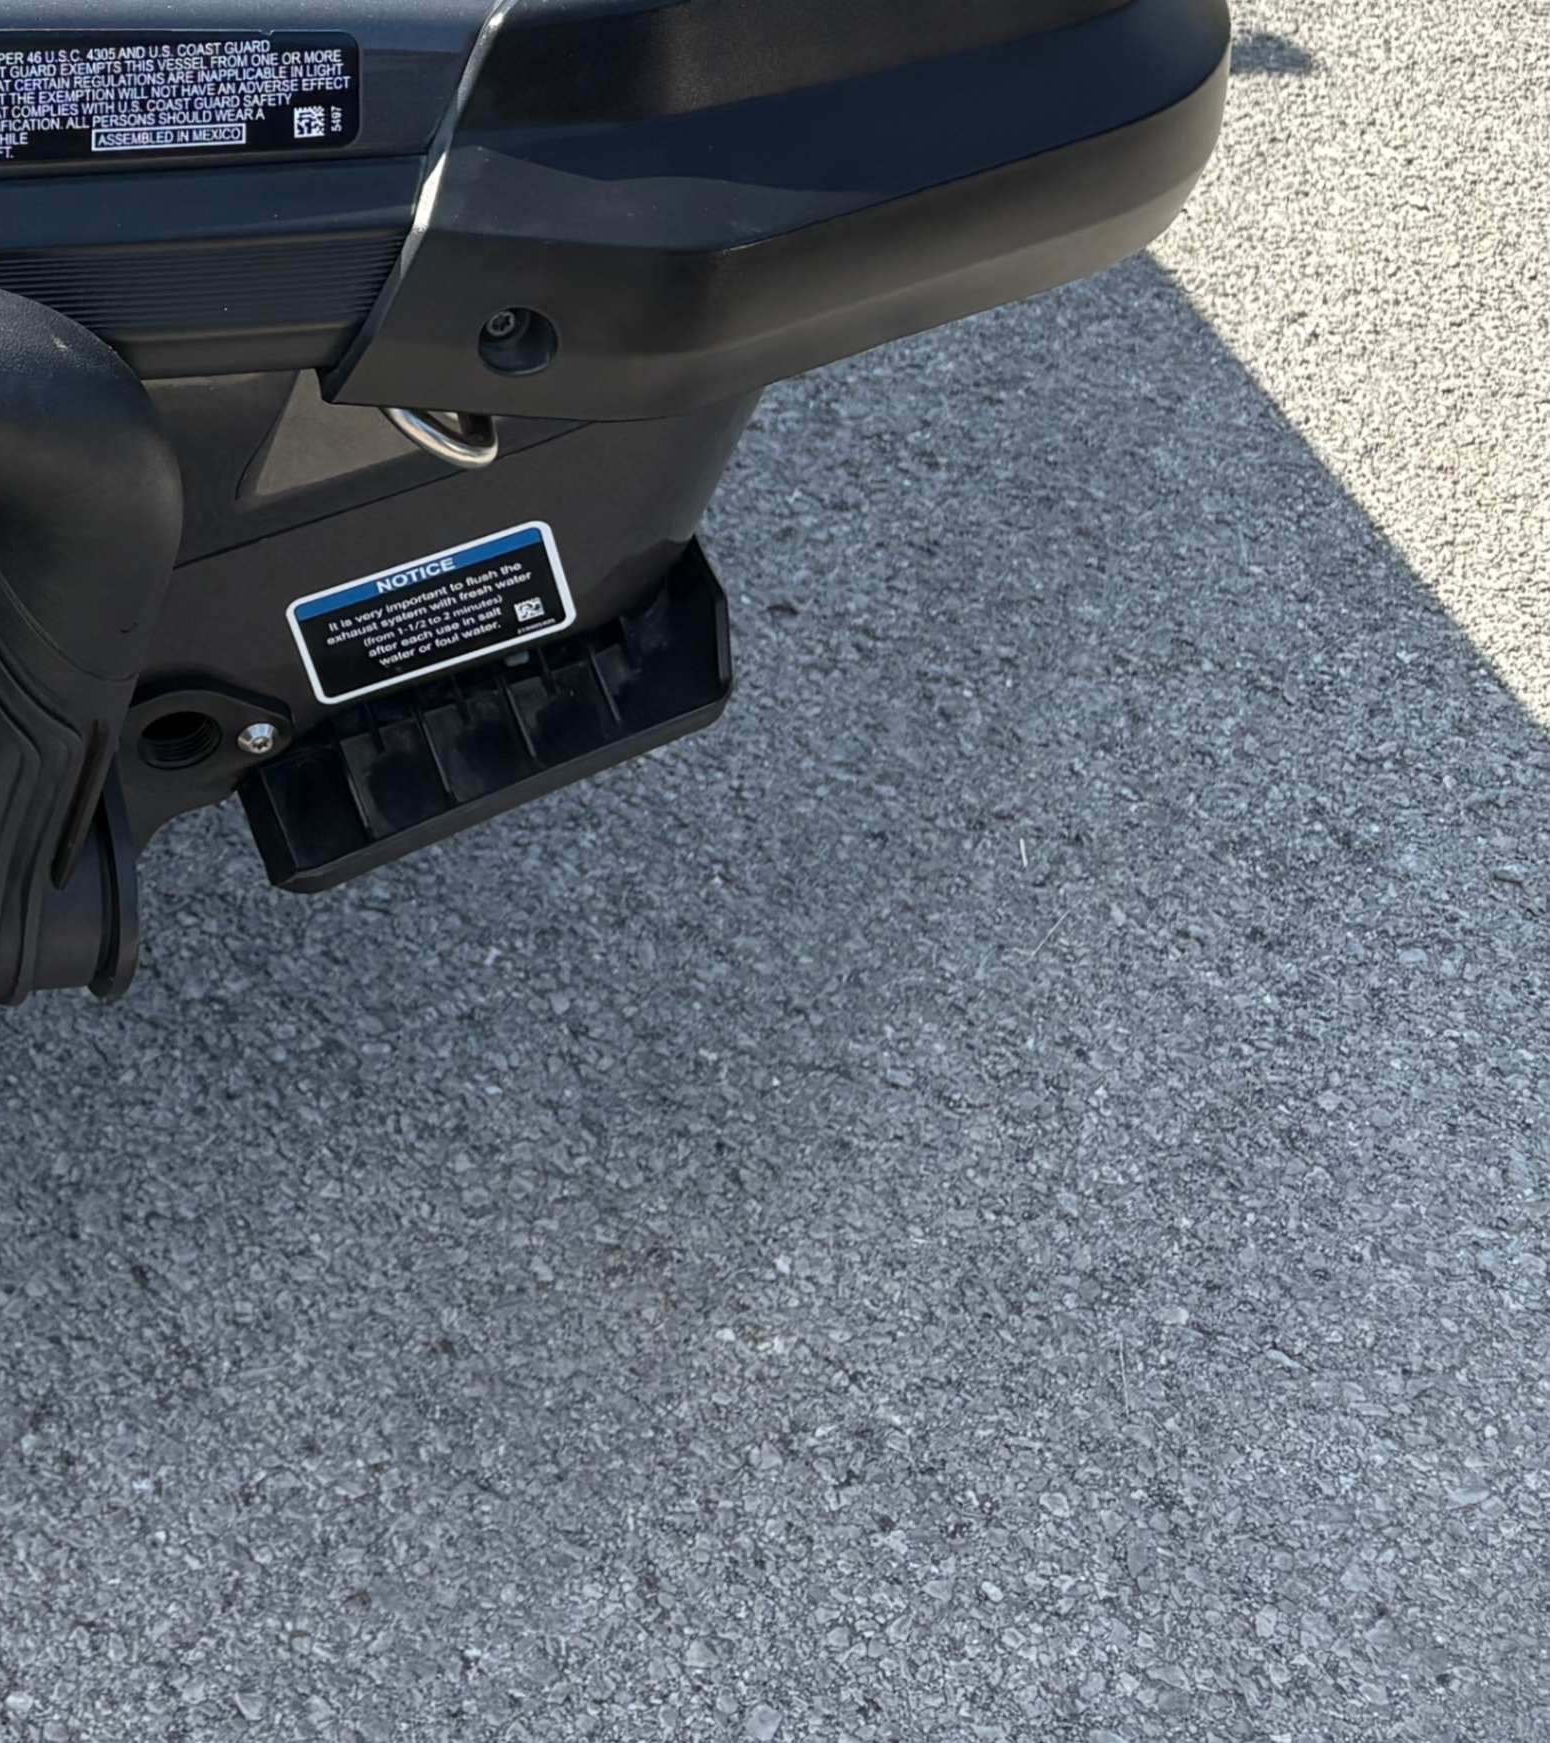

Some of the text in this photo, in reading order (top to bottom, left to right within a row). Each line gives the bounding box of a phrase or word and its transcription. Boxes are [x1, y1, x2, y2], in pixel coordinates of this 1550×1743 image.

[9, 64, 56, 78] GUARD
[59, 61, 121, 76] EXEMPTS
[126, 59, 154, 72] THIS
[157, 57, 205, 71] VESSEL
[210, 54, 248, 68] FROM
[250, 53, 278, 67] ONE
[281, 52, 300, 65] OR
[303, 50, 340, 64] MORE
[27, 51, 42, 63] 46
[44, 49, 82, 63] U.S.C.
[87, 48, 115, 61] 4305
[118, 46, 145, 59] AND
[148, 45, 173, 58] U.S.
[177, 43, 220, 56] COAST
[224, 40, 270, 54] GUARD
[11, 92, 35, 105] THE
[38, 89, 115, 103] EXEMPTION
[118, 87, 146, 100] WILL
[150, 86, 177, 98] NOT
[180, 84, 214, 97] HAVE
[217, 83, 236, 95] AN
[238, 80, 298, 94] ADVERSE
[301, 77, 349, 91] EFFECT
[15, 77, 70, 91] CERTAIN
[73, 73, 164, 88] REGULATIONS
[167, 71, 193, 84] ARE
[197, 67, 286, 83] INAPPLICABLE
[290, 66, 303, 78] IN
[306, 64, 342, 78] LIGHT
[11, 104, 78, 118] COMPLIES
[81, 102, 115, 115] WITH
[117, 101, 143, 113] U.S.
[146, 99, 190, 112] COAST
[193, 96, 240, 110] GUARD
[243, 94, 291, 107] SAFETY
[66, 117, 88, 129] ALL
[92, 113, 155, 128] PERSONS
[158, 110, 212, 125] SHOULD
[214, 108, 253, 122] WEAR
[255, 108, 264, 120] A
[98, 127, 240, 146] ASSEMBLED IN MEXICO
[375, 556, 456, 594] NOTICE
[325, 570, 533, 646] exhaust system with fresh water
[339, 617, 353, 628] is
[354, 608, 383, 625] very
[385, 585, 448, 615] important
[448, 580, 464, 592] to
[465, 568, 498, 587] flush
[499, 560, 521, 575] the
[362, 593, 503, 648] (from 1-1/2 to 2 minutes)
[367, 606, 502, 658] after each use in salt
[378, 647, 416, 667] water
[418, 643, 432, 653] or
[434, 632, 460, 648] foul
[461, 618, 501, 640] water.
